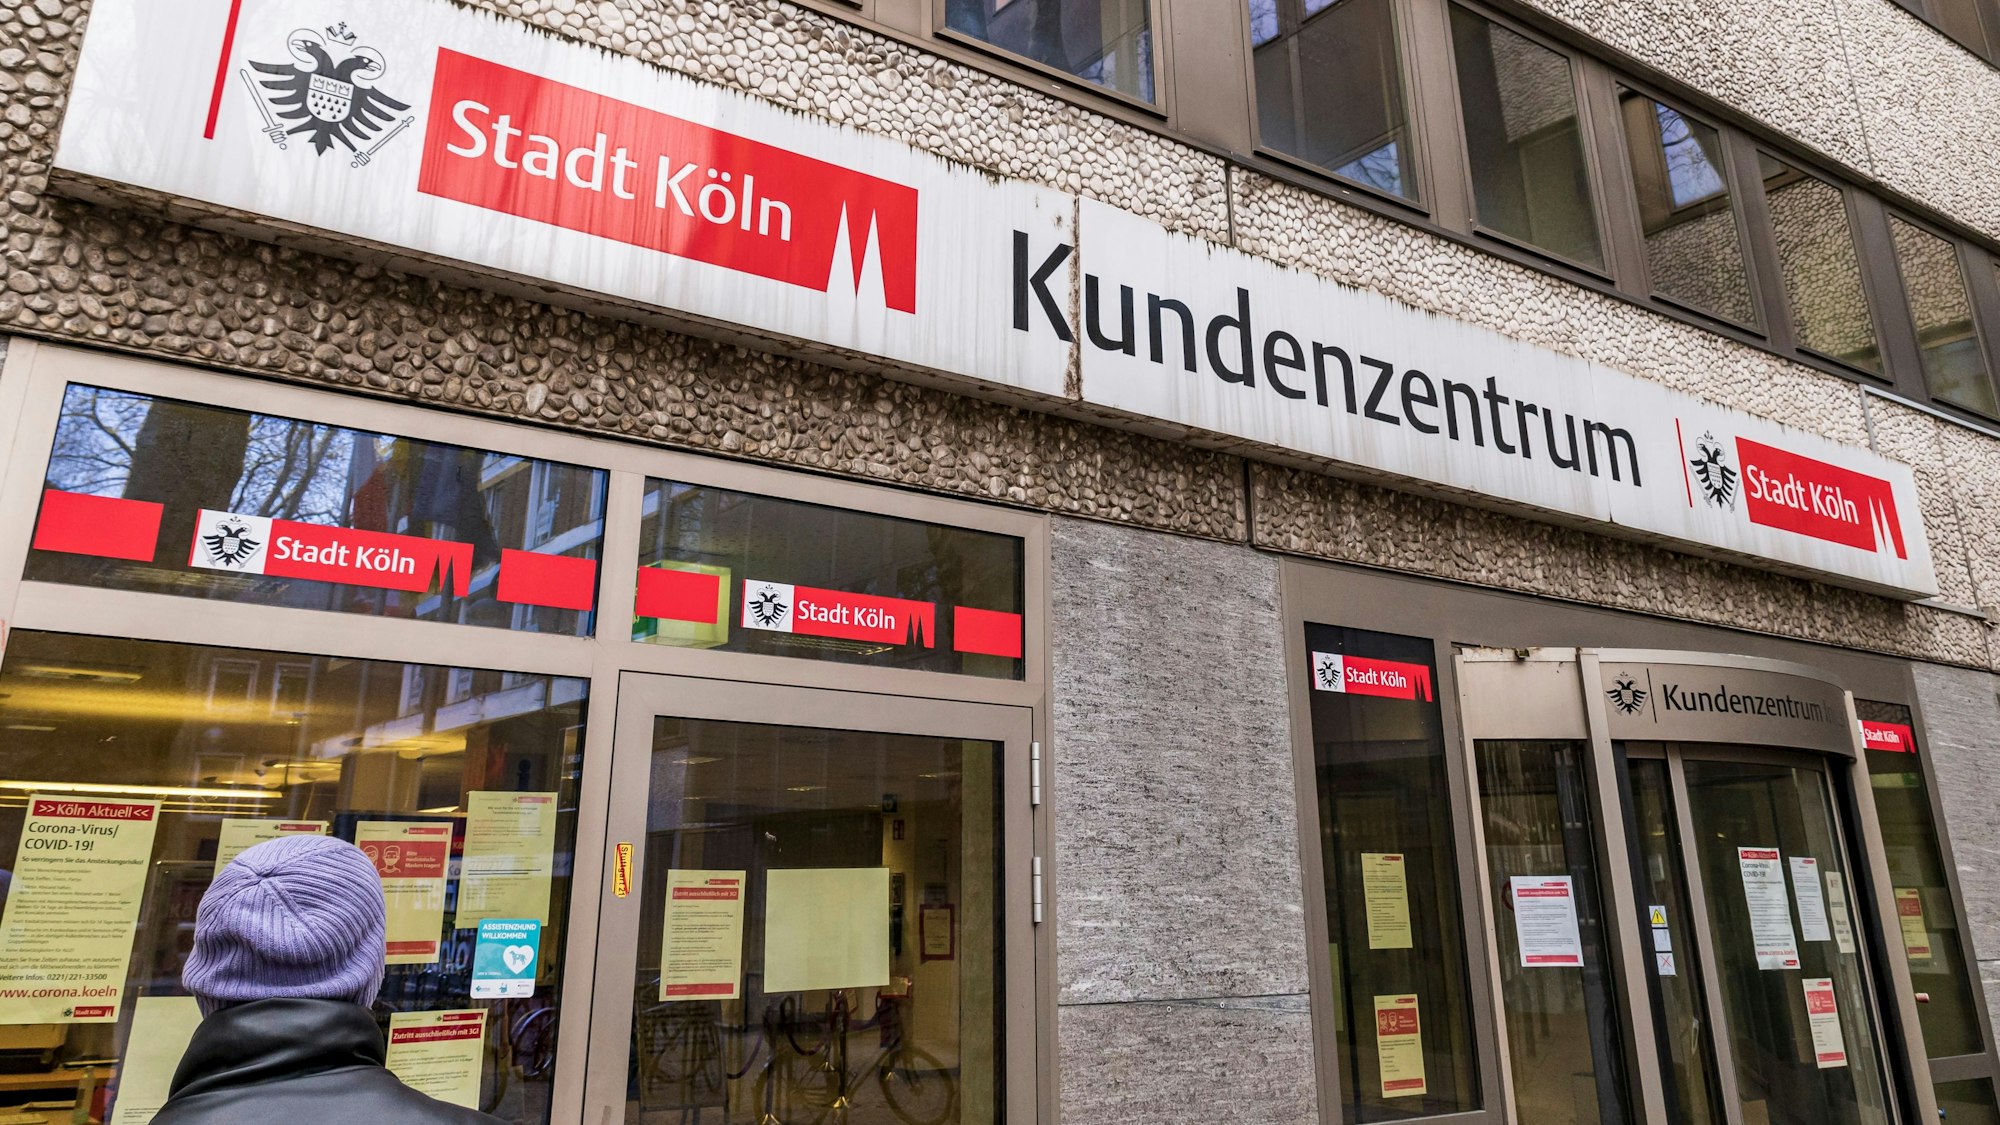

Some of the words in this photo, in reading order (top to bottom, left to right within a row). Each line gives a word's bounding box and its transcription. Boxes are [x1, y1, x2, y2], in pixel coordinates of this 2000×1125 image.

[446, 99, 637, 201] Stadt
[656, 155, 792, 242] Köln
[1012, 229, 1642, 488] Kundenzentrum
[1746, 464, 1809, 512] Stadt
[1809, 482, 1860, 524] Köln
[273, 536, 350, 568] Stadt
[355, 545, 416, 575] Köln
[798, 600, 850, 623] Stadt
[853, 606, 896, 630] Köln
[1346, 666, 1379, 685] Stadt
[1380, 670, 1407, 688] Köln
[1662, 684, 1824, 723] Kundenzentrum
[1864, 728, 1884, 742] Stadt
[1883, 730, 1899, 744] Köln
[28, 821, 119, 839] Corona-Virus/
[24, 838, 94, 851] COVID-19!
[481, 932, 527, 940] WILLKOMMEN
[482, 923, 537, 931] ASSISTENZHUND
[392, 1031, 415, 1040] Zutritt
